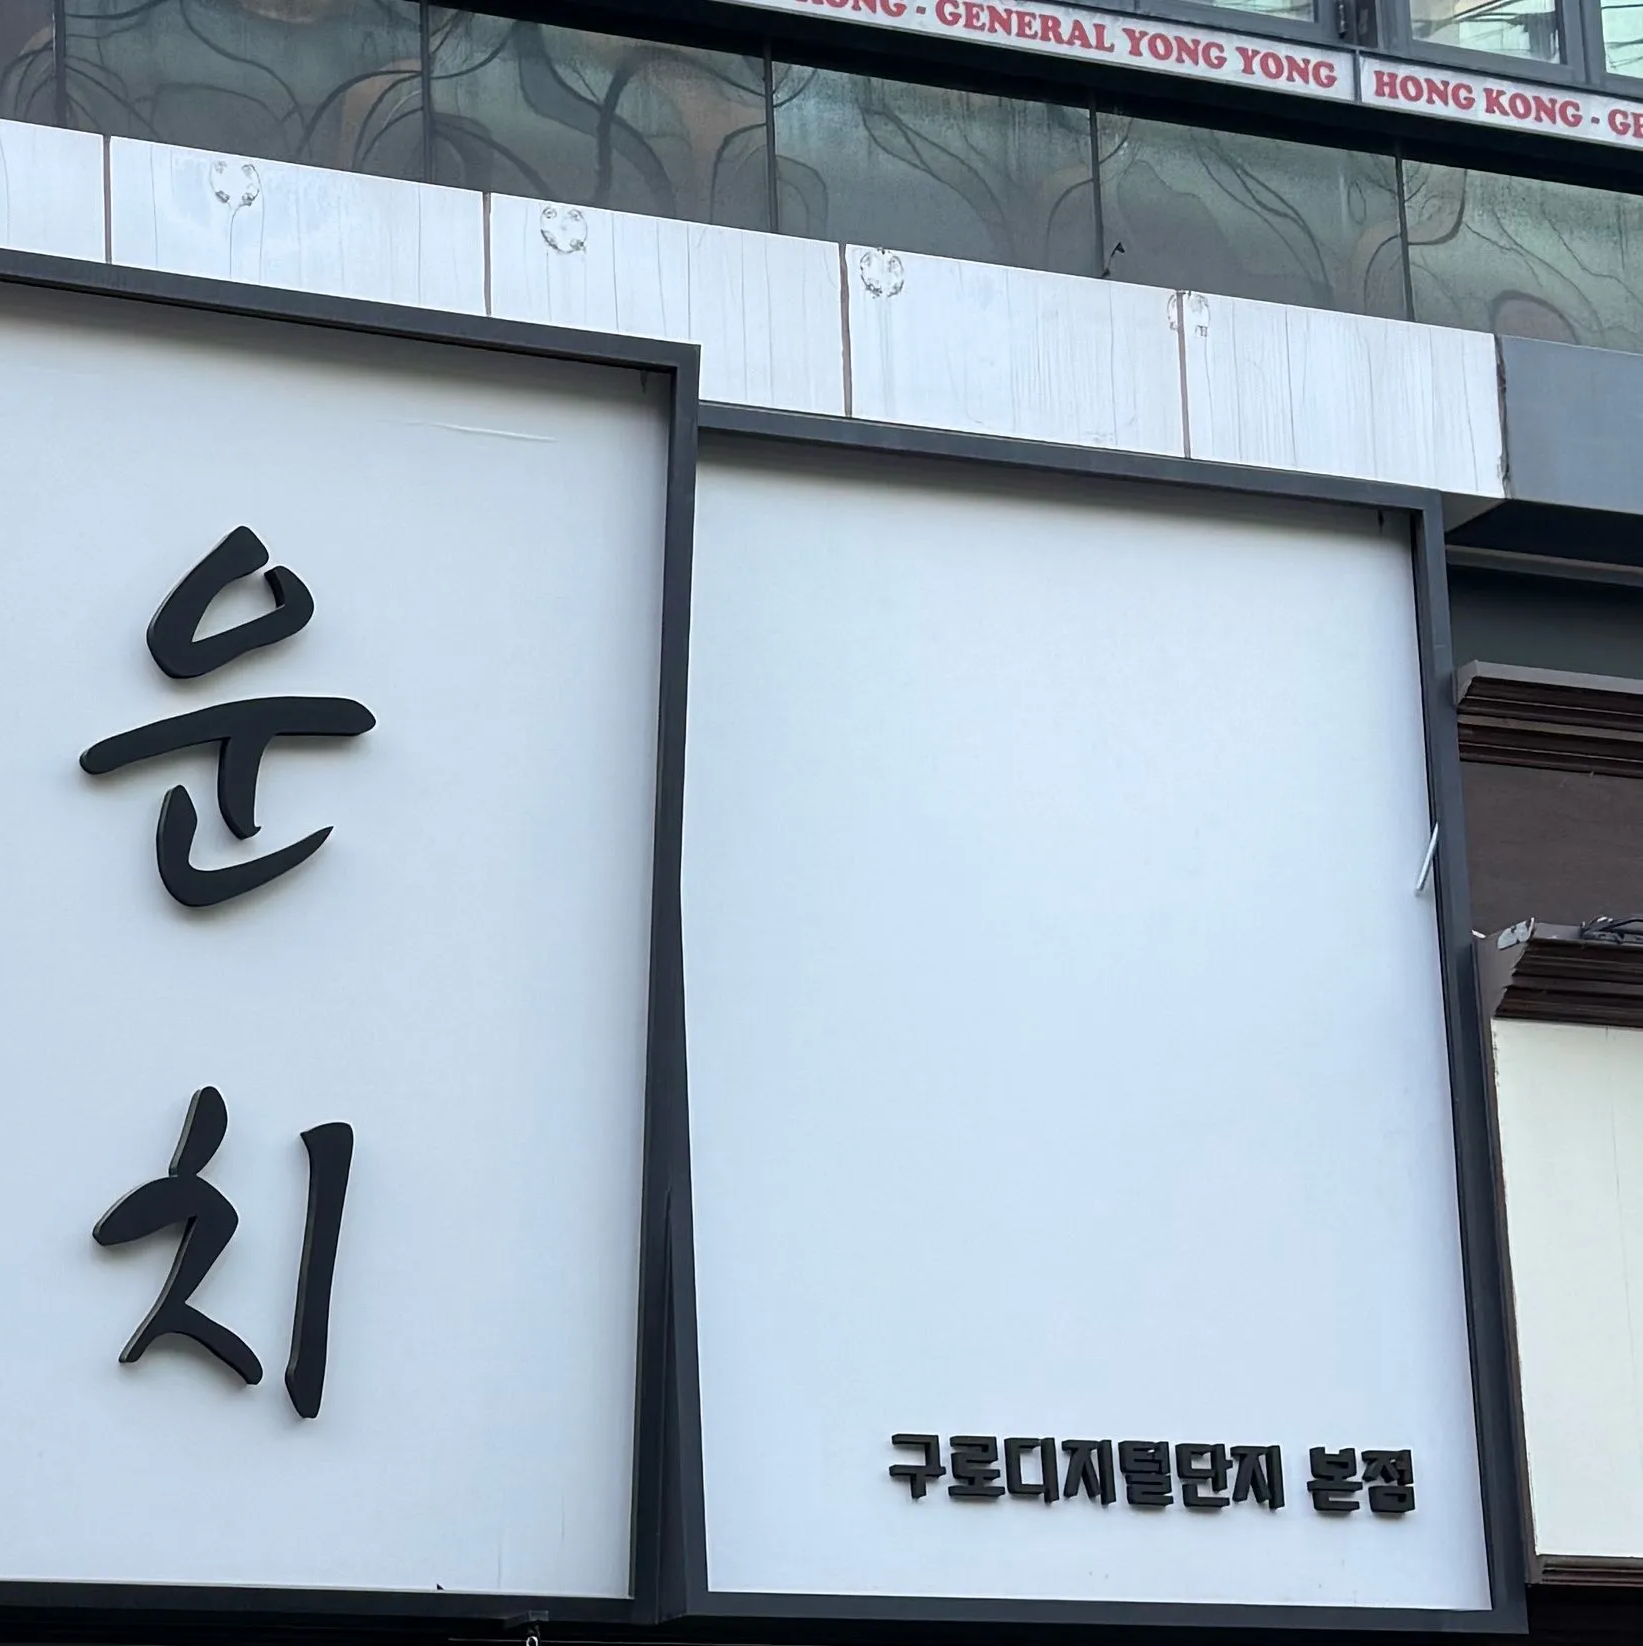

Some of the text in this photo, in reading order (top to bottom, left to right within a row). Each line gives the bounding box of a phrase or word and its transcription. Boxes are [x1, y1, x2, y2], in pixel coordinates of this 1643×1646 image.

[935, 0, 1114, 53] GENERAL
[1122, 28, 1227, 69] YONG
[1236, 46, 1338, 88] YONG
[1374, 70, 1476, 110] HONG
[1483, 87, 1583, 127] KONG
[79, 526, 376, 1418] 운치
[889, 1433, 1417, 1514] 구로디지털단지 본점
